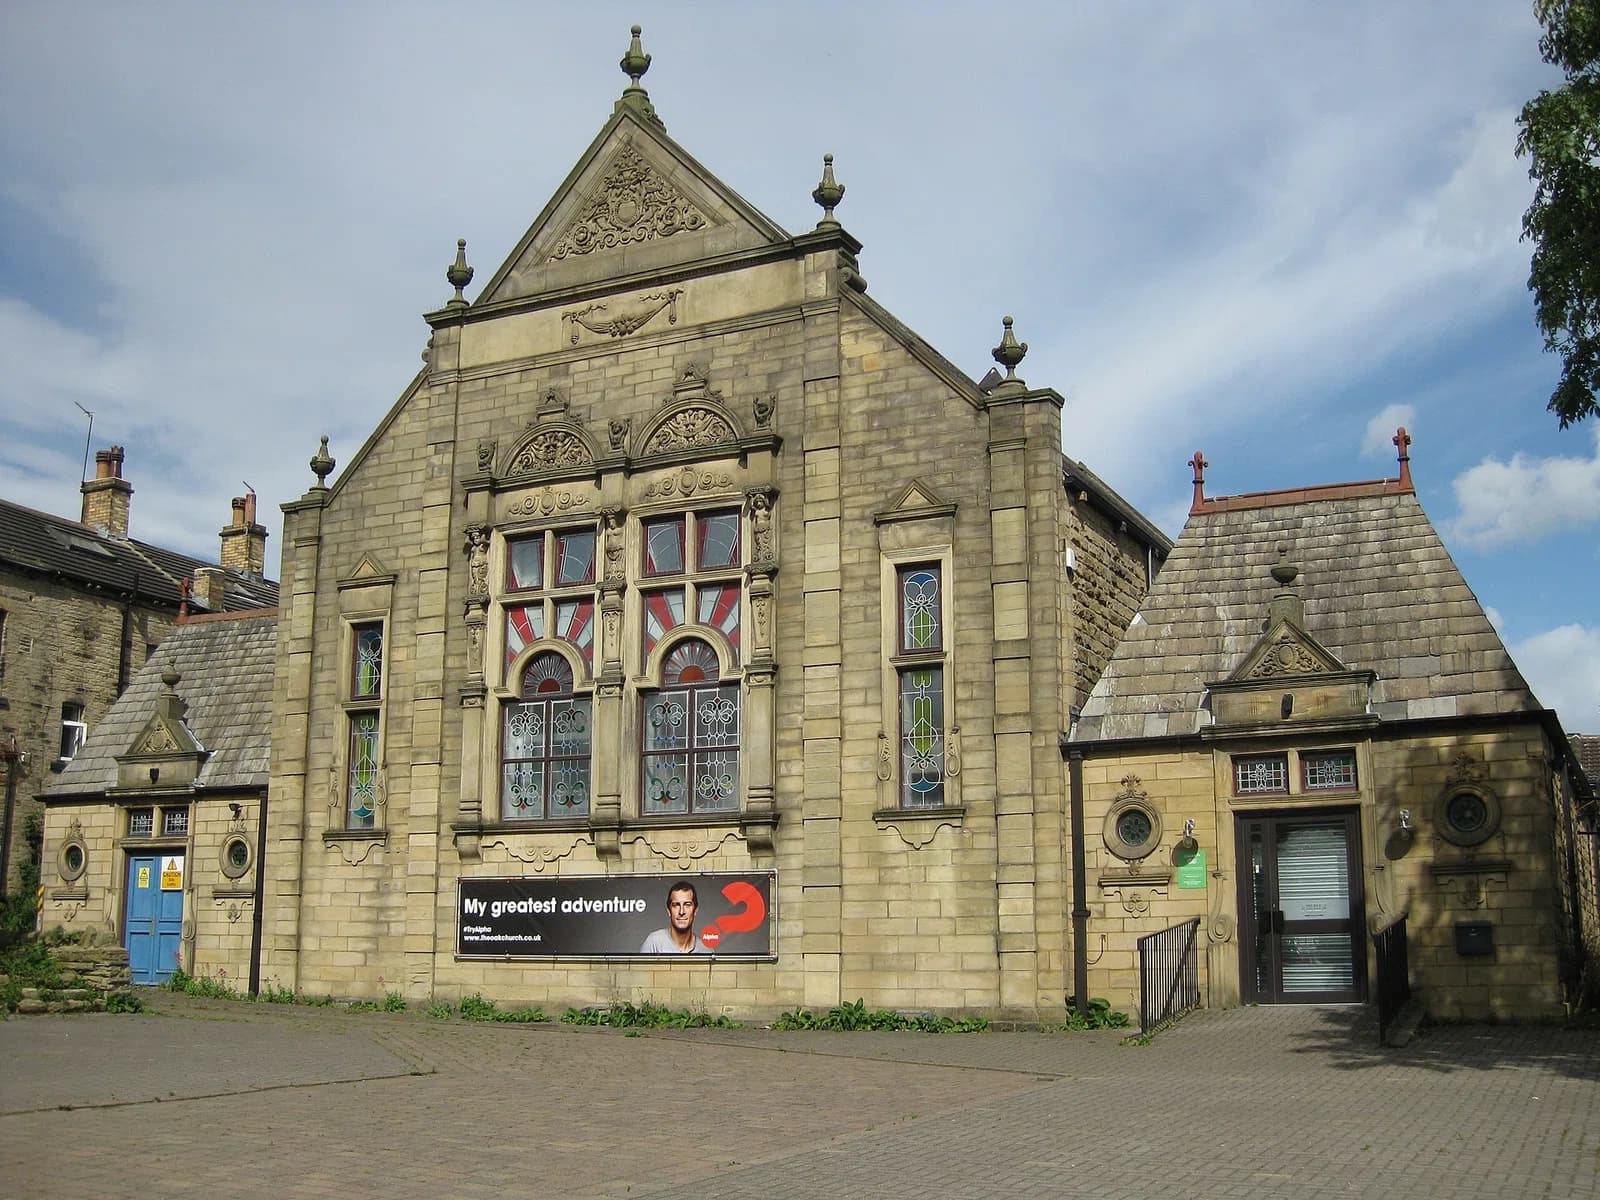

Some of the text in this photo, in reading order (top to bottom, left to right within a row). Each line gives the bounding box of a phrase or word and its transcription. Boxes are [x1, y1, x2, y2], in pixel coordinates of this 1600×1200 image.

[464, 896, 646, 918] My greatest adventure
